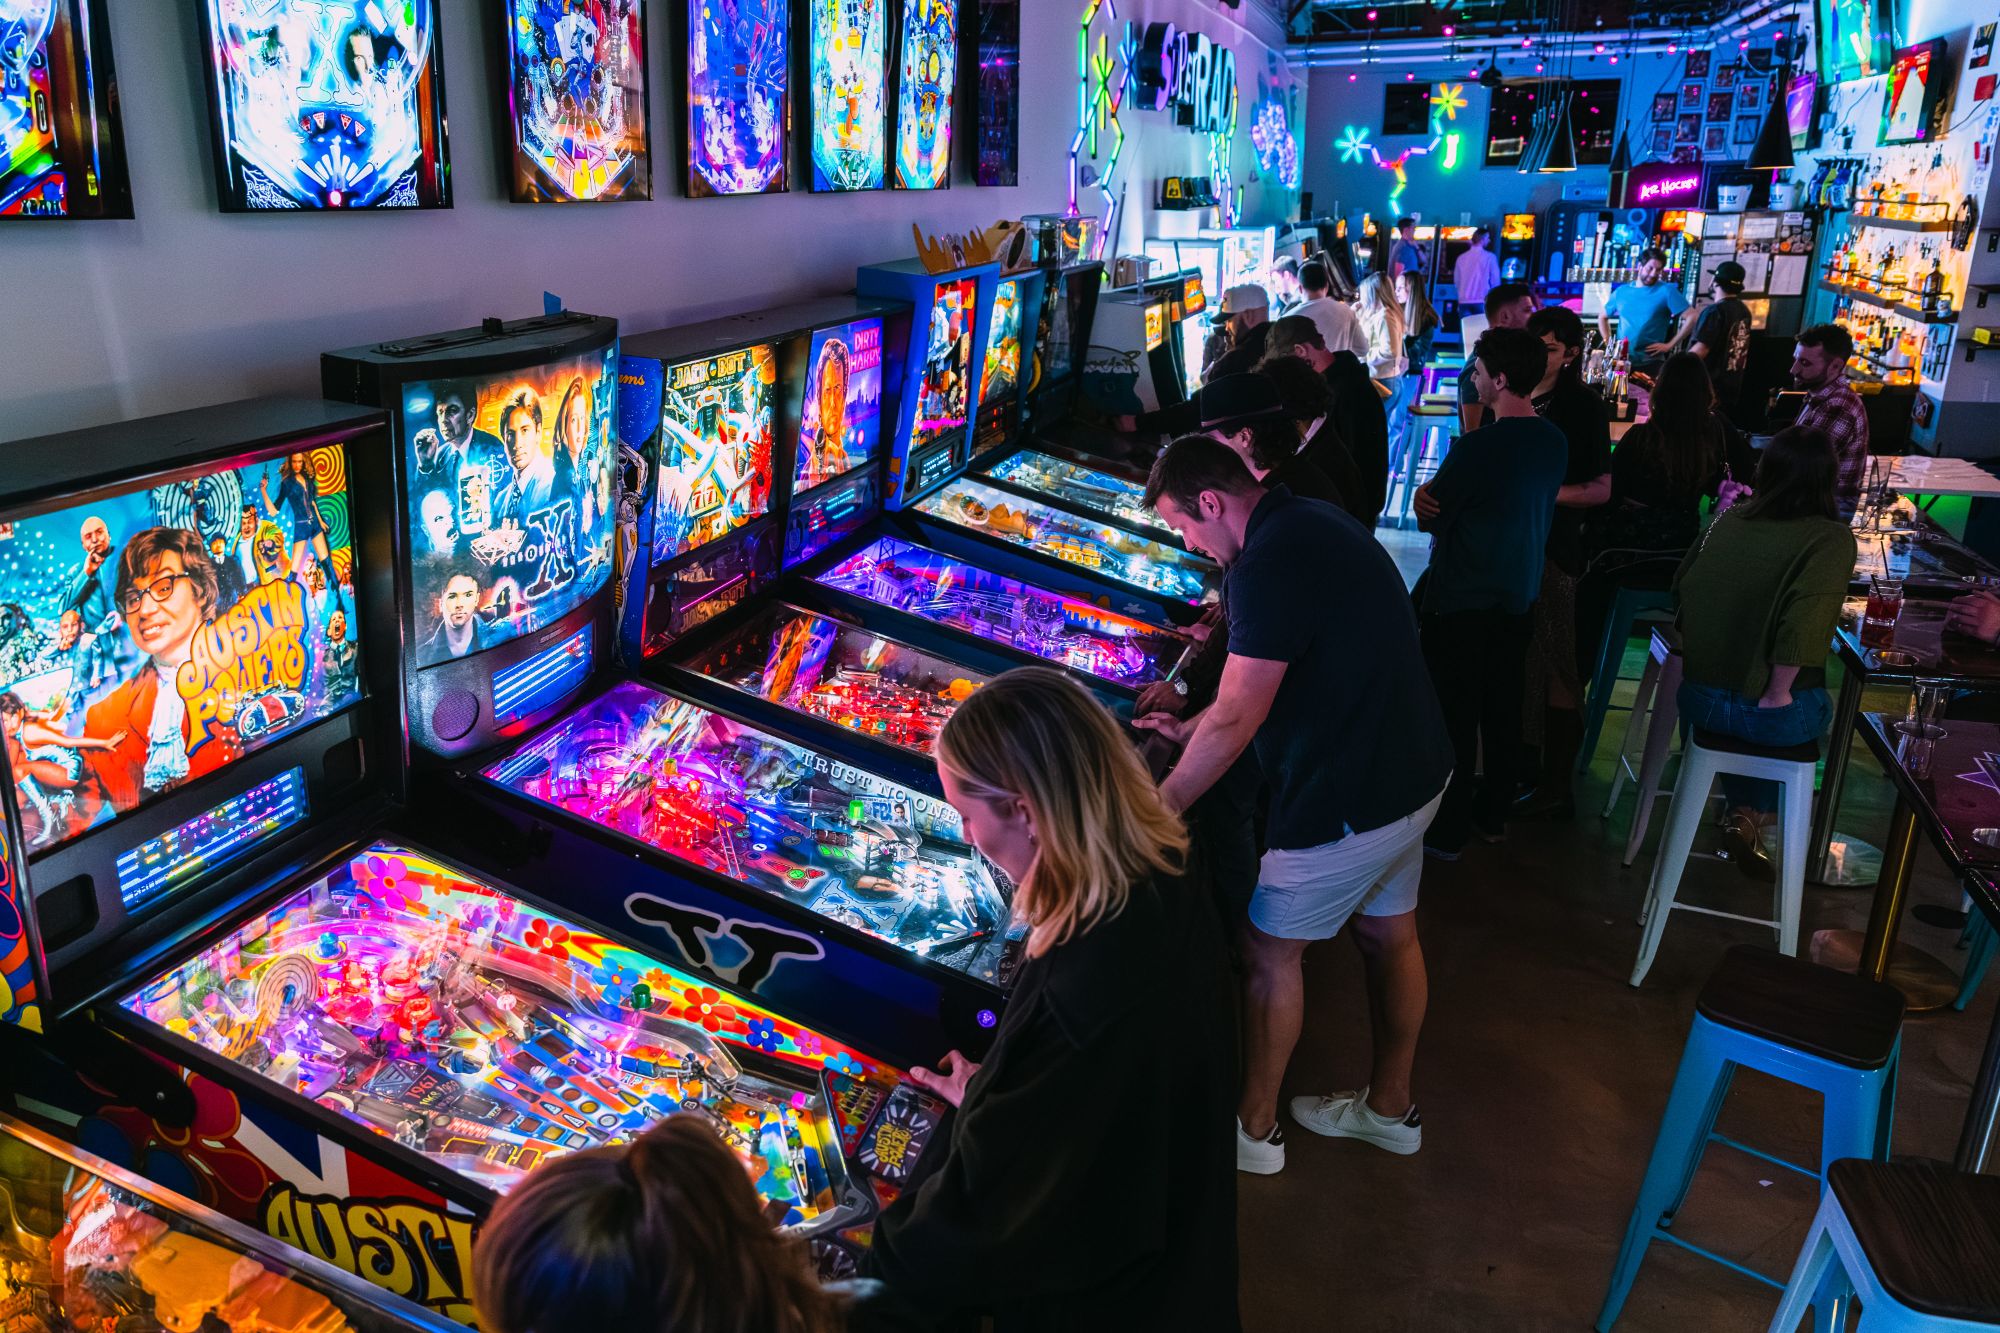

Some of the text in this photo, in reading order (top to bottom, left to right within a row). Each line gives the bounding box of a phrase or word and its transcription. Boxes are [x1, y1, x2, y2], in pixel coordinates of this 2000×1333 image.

[854, 327, 880, 352] DIRTY
[673, 352, 746, 390] JACK BOT
[177, 578, 307, 700] AUSTIN
[184, 626, 308, 756] POWERS
[801, 752, 872, 791] TRUST
[879, 782, 907, 804] NO
[914, 798, 961, 825] ONE
[405, 1074, 439, 1099] 1967
